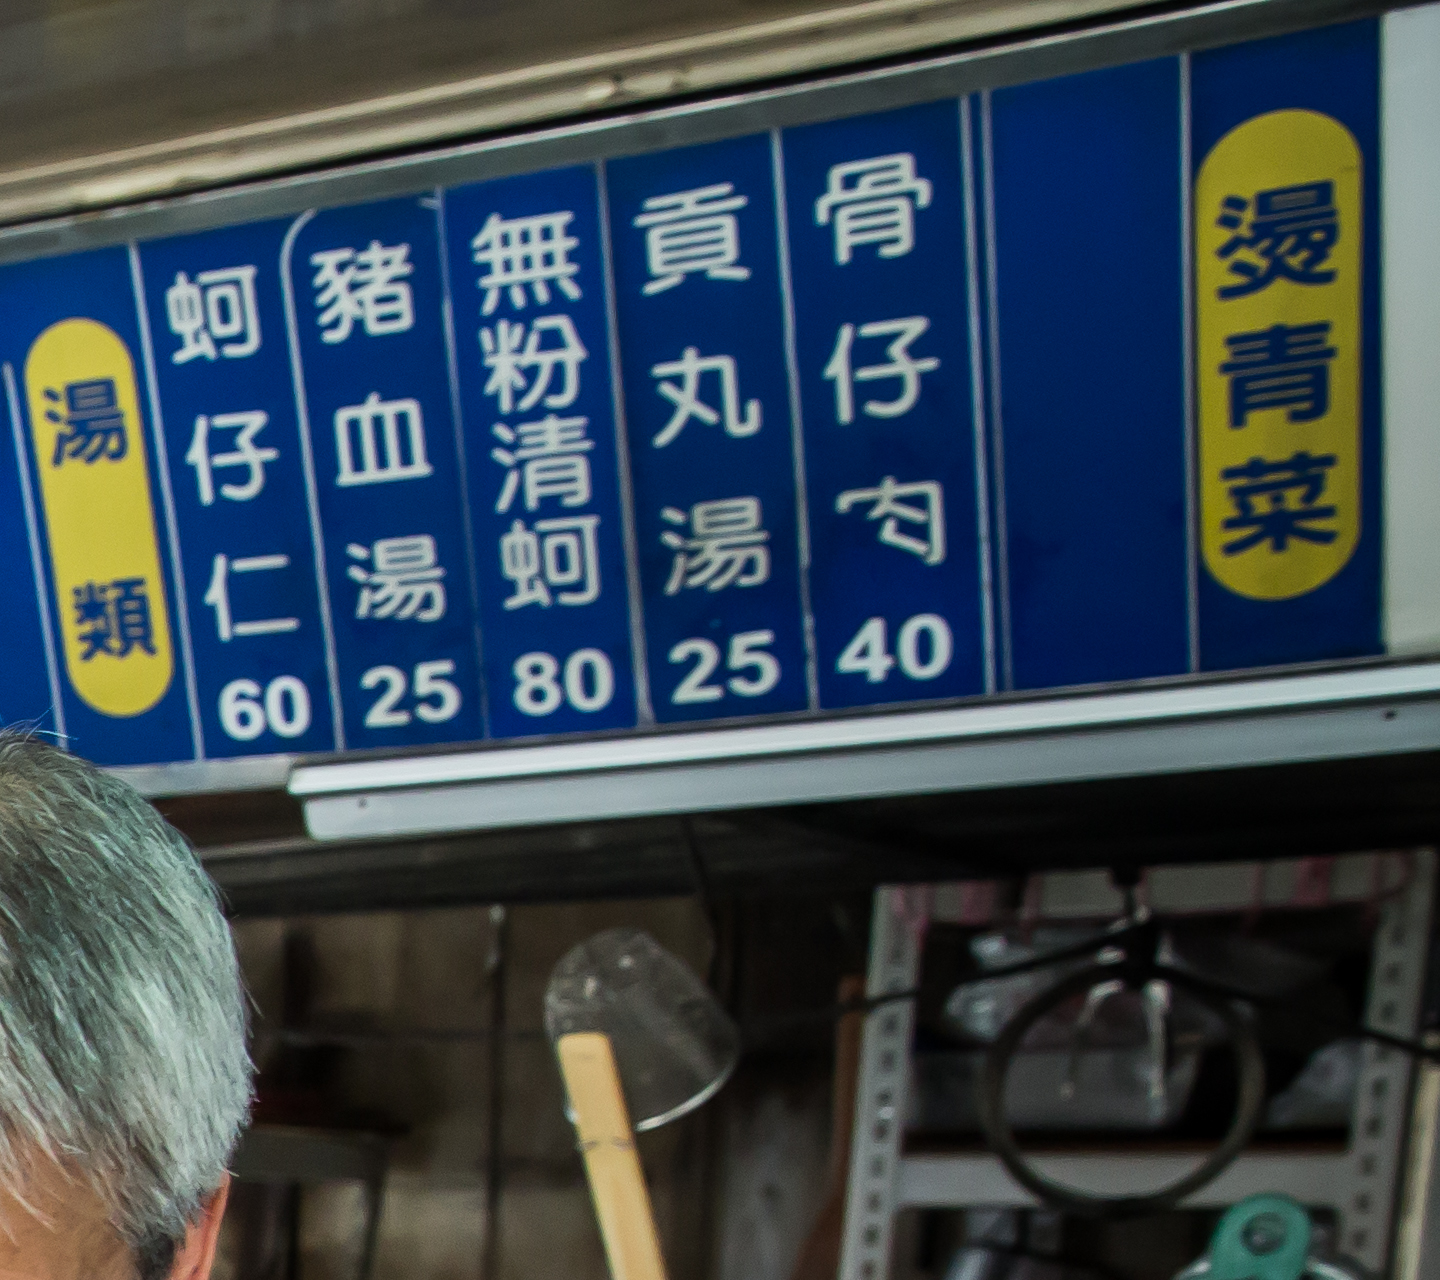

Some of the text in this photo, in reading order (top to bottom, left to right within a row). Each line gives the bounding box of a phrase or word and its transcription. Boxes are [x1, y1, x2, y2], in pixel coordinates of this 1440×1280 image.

[43, 377, 157, 661] 湯類
[165, 264, 299, 642] 蚵仔仁
[310, 240, 447, 622] 豬血湯
[472, 210, 601, 611] 無粉清蚵
[634, 183, 771, 596] 貢丸湯
[814, 151, 948, 566] 骨仔肉
[1214, 178, 1340, 558] 燙青菜
[218, 675, 311, 740] 60
[361, 660, 462, 728] 25
[512, 648, 614, 716] 80
[669, 631, 781, 705] 25
[837, 614, 953, 682] 40
